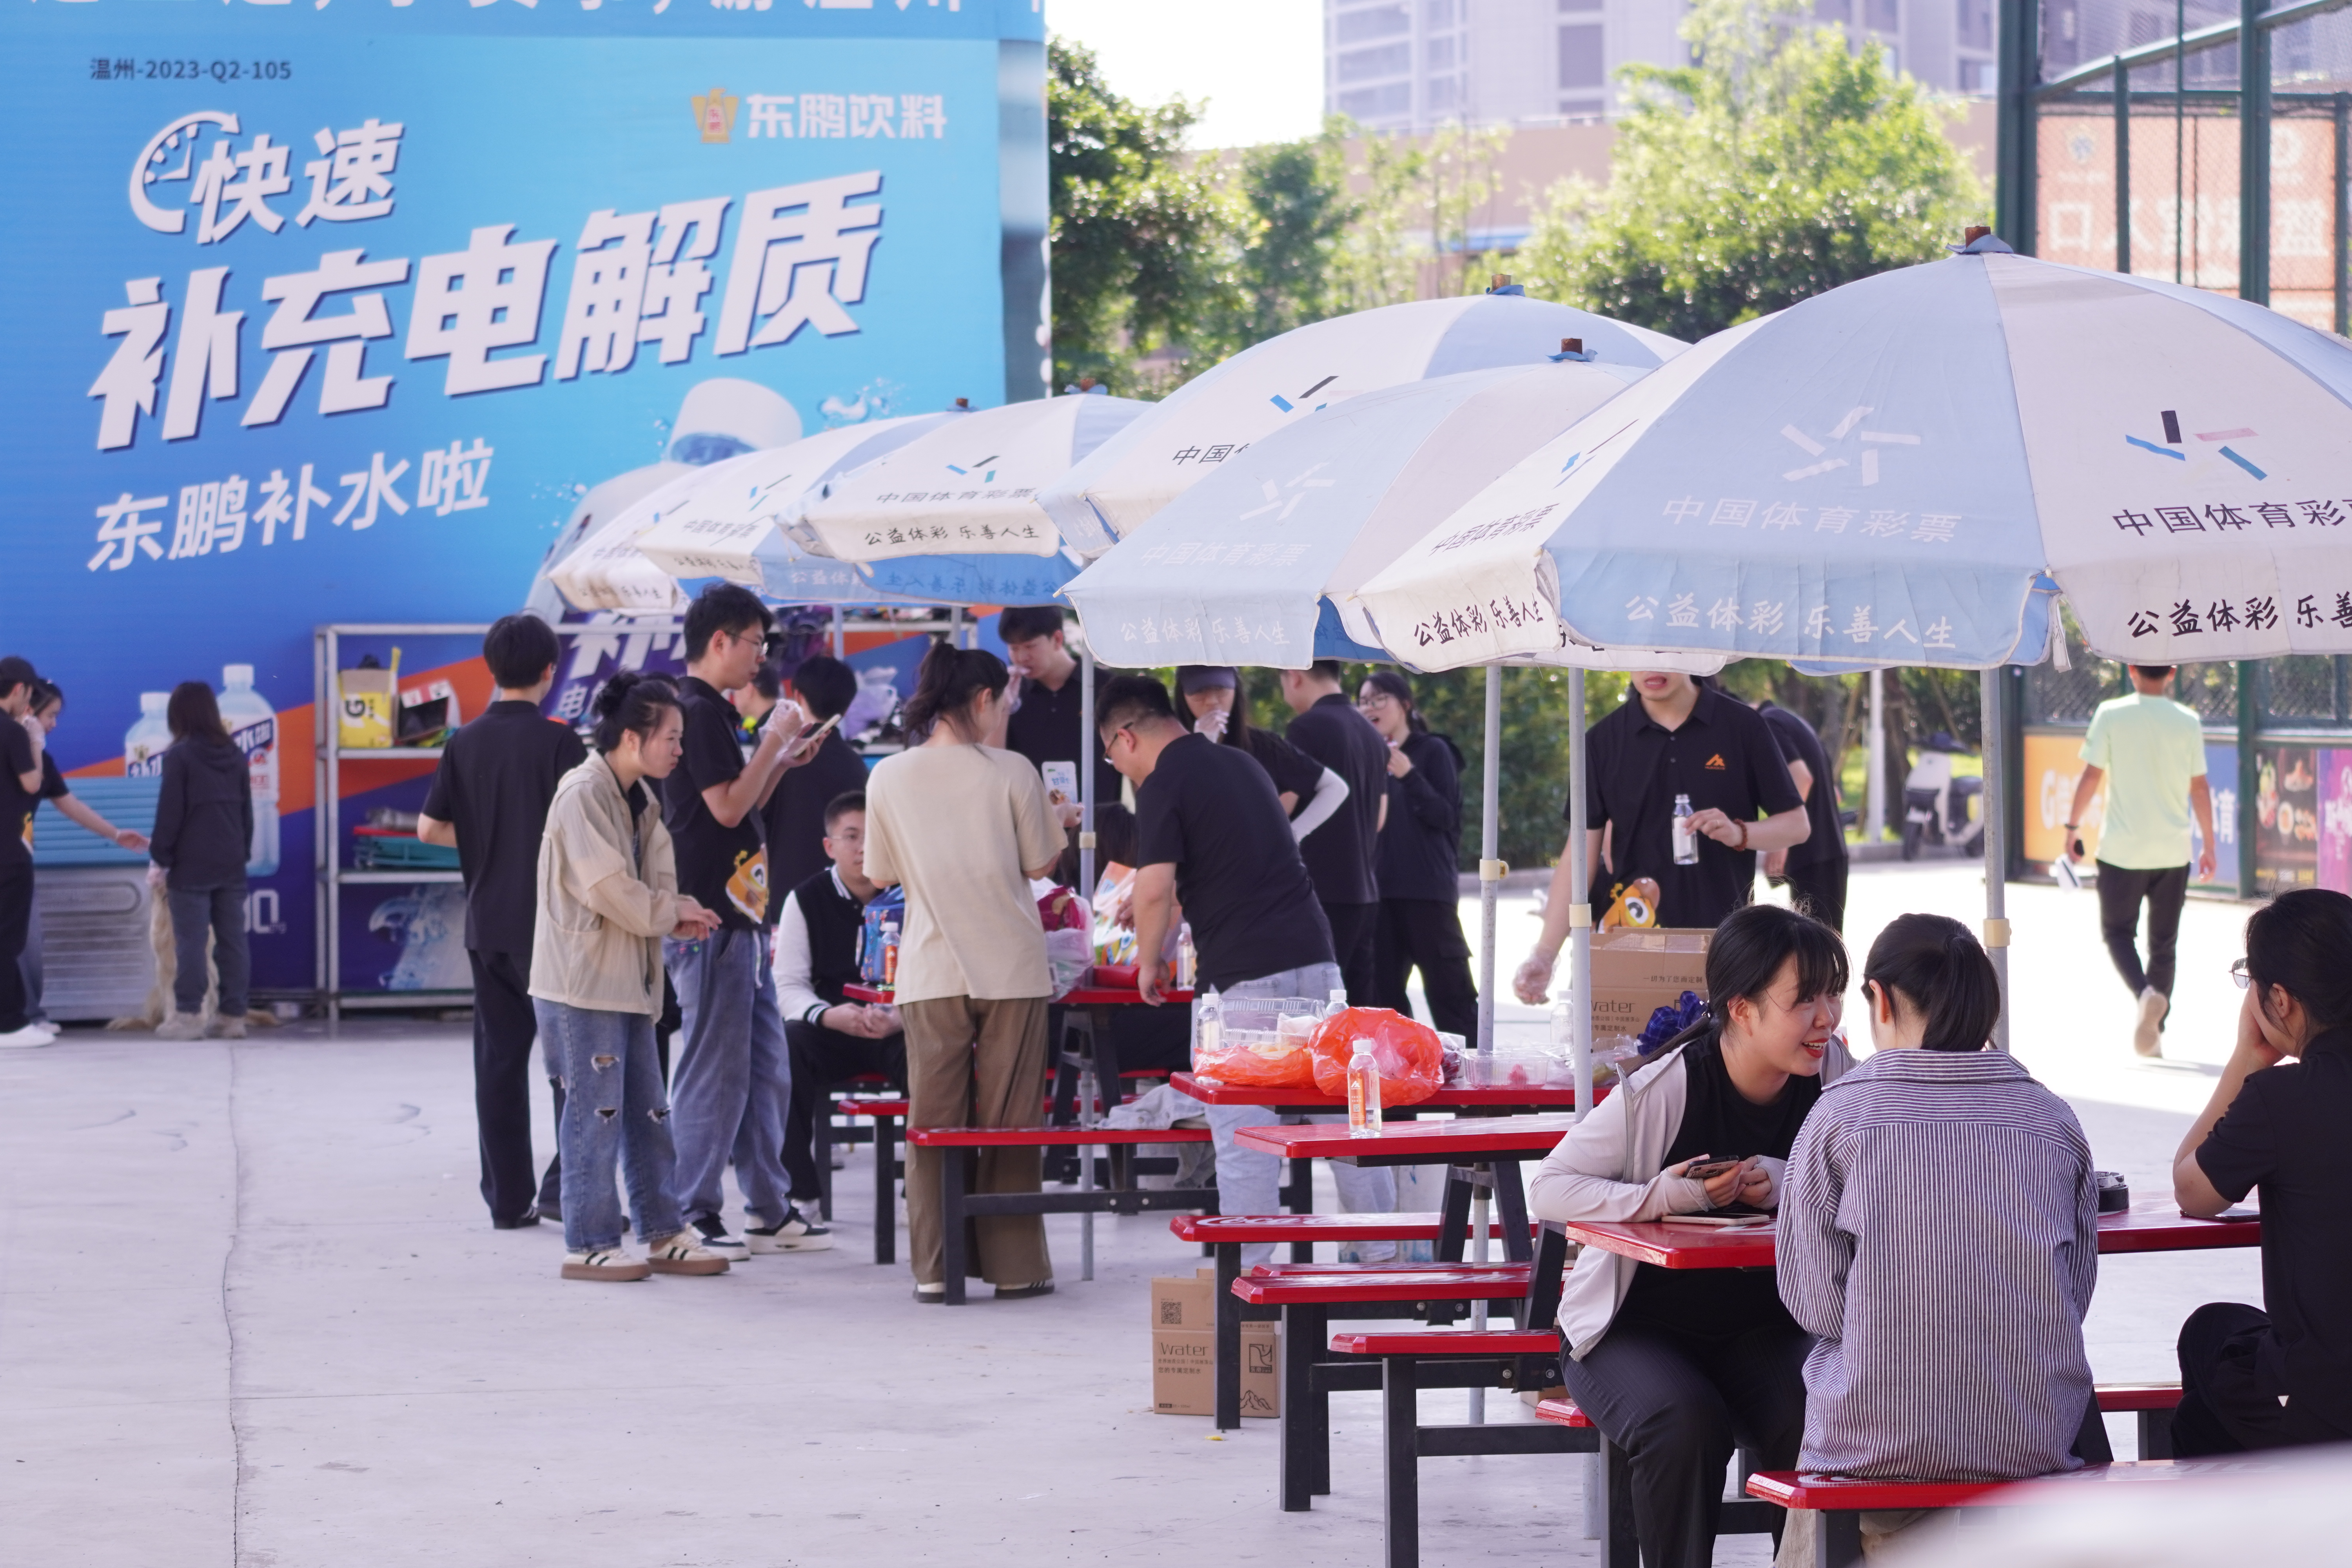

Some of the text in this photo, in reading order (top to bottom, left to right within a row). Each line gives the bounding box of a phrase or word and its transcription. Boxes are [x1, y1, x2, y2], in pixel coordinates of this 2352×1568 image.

[90, 58, 292, 83] 温州-2023-Q2-105
[746, 93, 948, 140] 东鹏饮料
[190, 118, 405, 245] 快速
[87, 170, 884, 453] 补充电解质
[87, 438, 495, 572] 东鹏补水啦
[877, 487, 1037, 504] 中国体育彩票
[864, 524, 1040, 545] 公益体彩 乐善人生
[1428, 503, 1560, 557] 中国体育彩票
[1662, 494, 1963, 544] 中国体育彩票
[1140, 542, 1312, 567] 中国体育彩票
[1120, 616, 1202, 644] 公益体彩
[1211, 616, 1290, 645] 乐善人生
[1414, 592, 1544, 647] 公益体彩 乐善人生
[1624, 590, 1957, 650] 公益体彩 乐善人生
[2127, 596, 2279, 639] 公益体彩
[1643, 975, 1703, 984] 一切为了您而定制
[1160, 1341, 1209, 1356] Water
